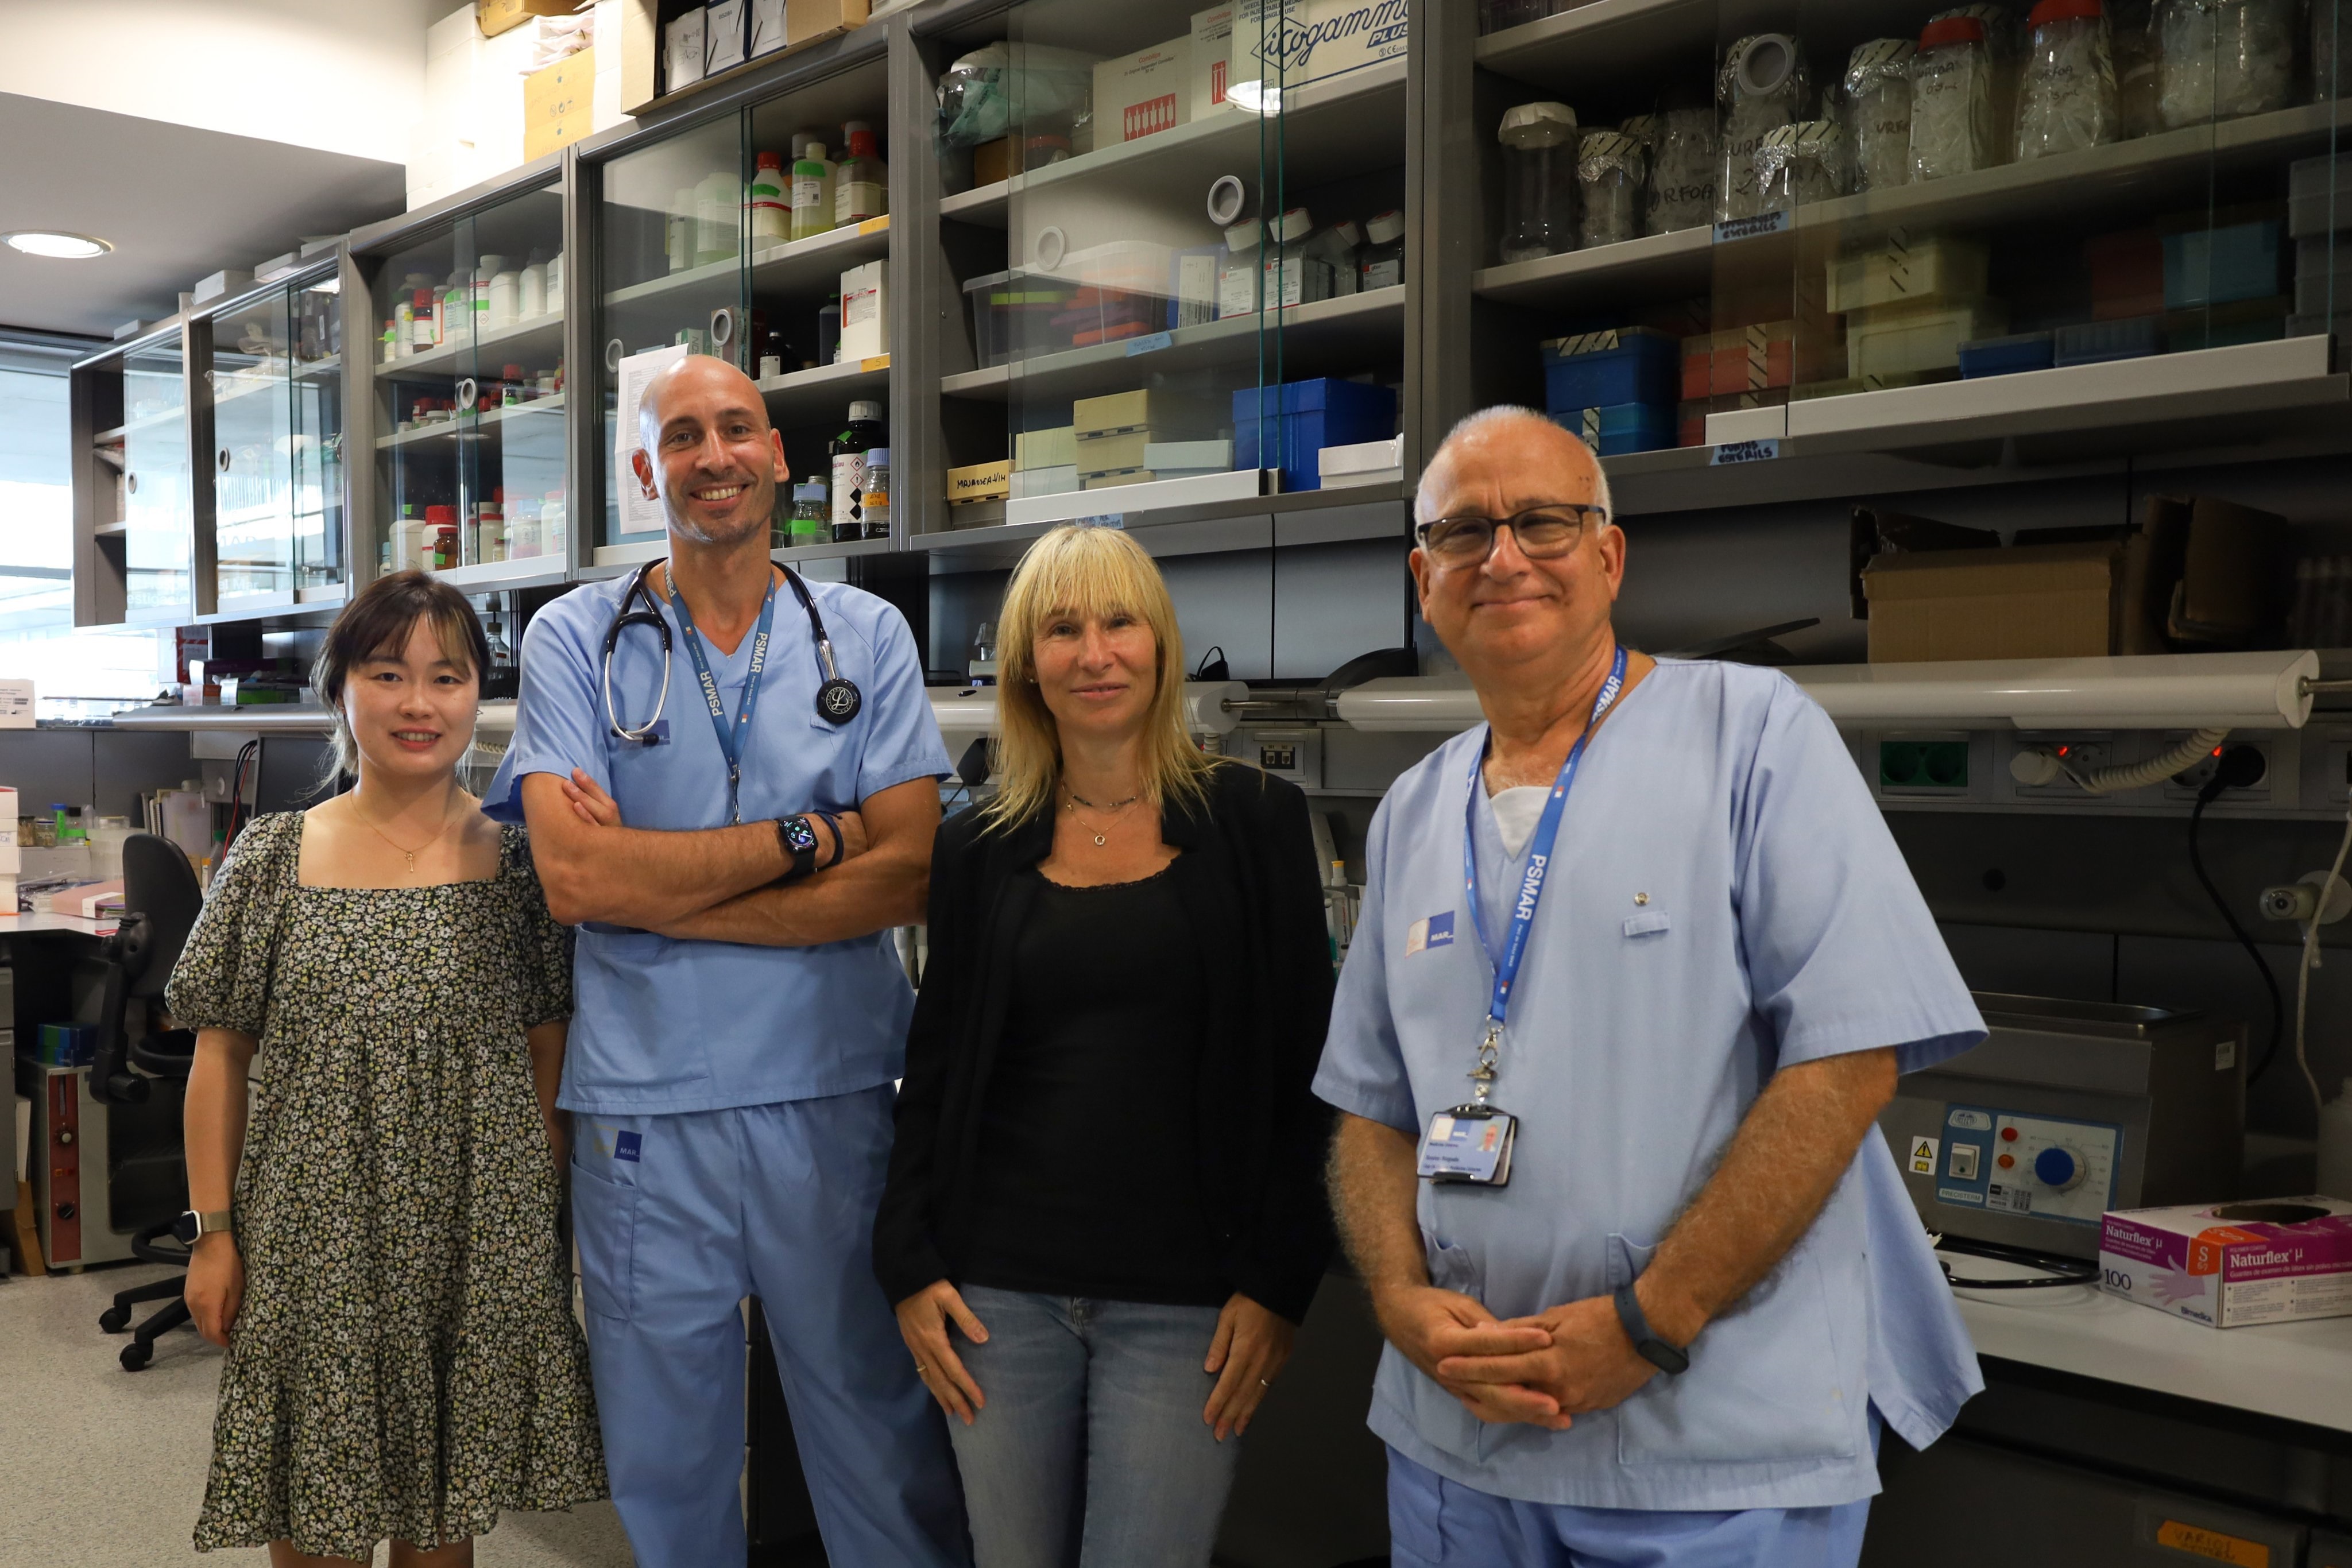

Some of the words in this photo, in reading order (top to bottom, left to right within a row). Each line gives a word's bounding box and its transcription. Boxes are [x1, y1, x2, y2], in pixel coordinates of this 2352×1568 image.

[1239, 12, 1248, 20] FOR
[1250, 16, 1261, 24] FOR
[1285, 6, 1295, 14] USE
[1139, 52, 1160, 63] Combitips
[750, 632, 769, 673] PSMAR
[699, 670, 724, 717] PSMAR
[1515, 854, 1547, 922] PSMAR
[1942, 1190, 1981, 1201] PRECISTERM
[2199, 1246, 2209, 1263] S
[2105, 1268, 2132, 1291] 100
